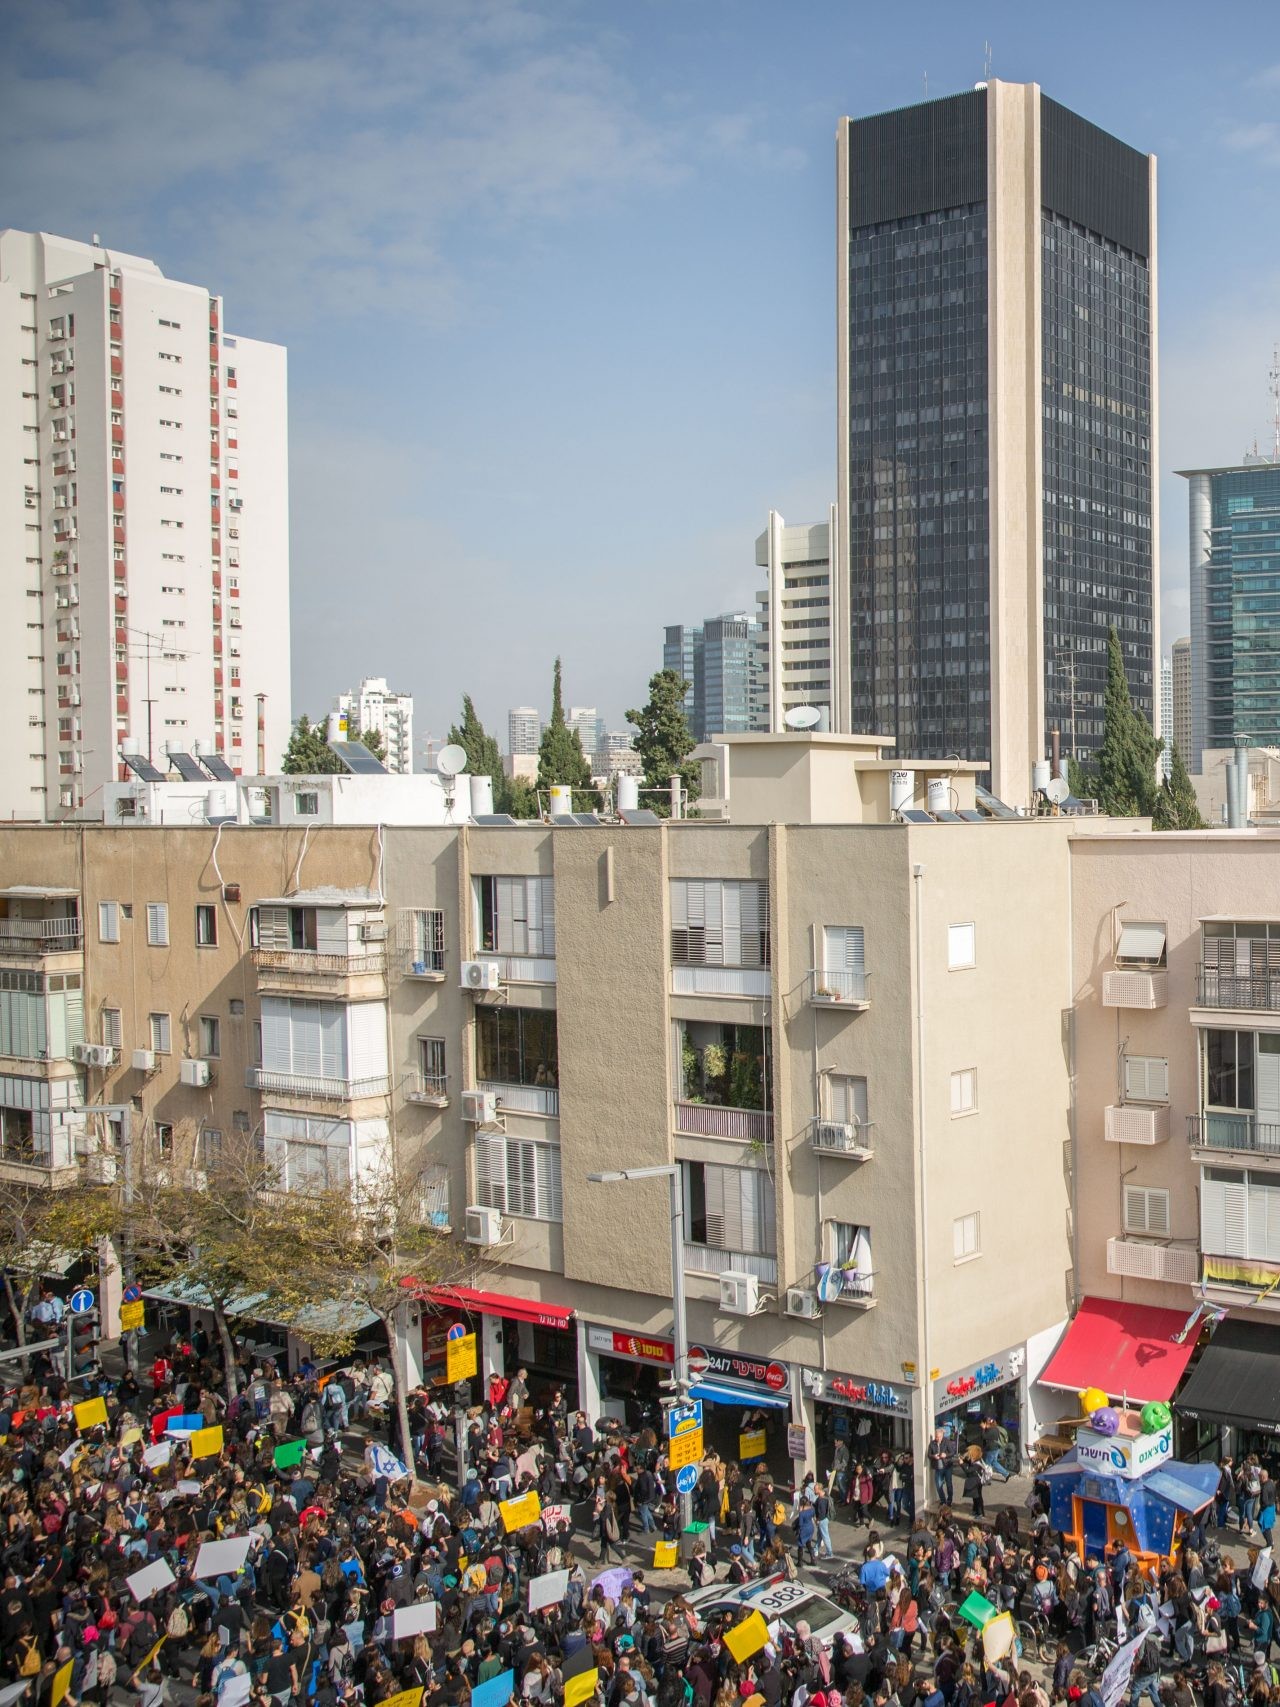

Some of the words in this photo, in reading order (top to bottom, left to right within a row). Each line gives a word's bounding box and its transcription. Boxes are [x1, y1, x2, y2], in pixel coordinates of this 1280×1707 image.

[710, 1357, 731, 1372] 24/7
[732, 1359, 766, 1380] סיטי
[832, 1376, 867, 1403] Gadget
[866, 1382, 899, 1407] Mobile
[1079, 1446, 1110, 1461] חישגד
[1138, 1444, 1159, 1463] צ'אנס
[760, 1586, 805, 1609] 968
